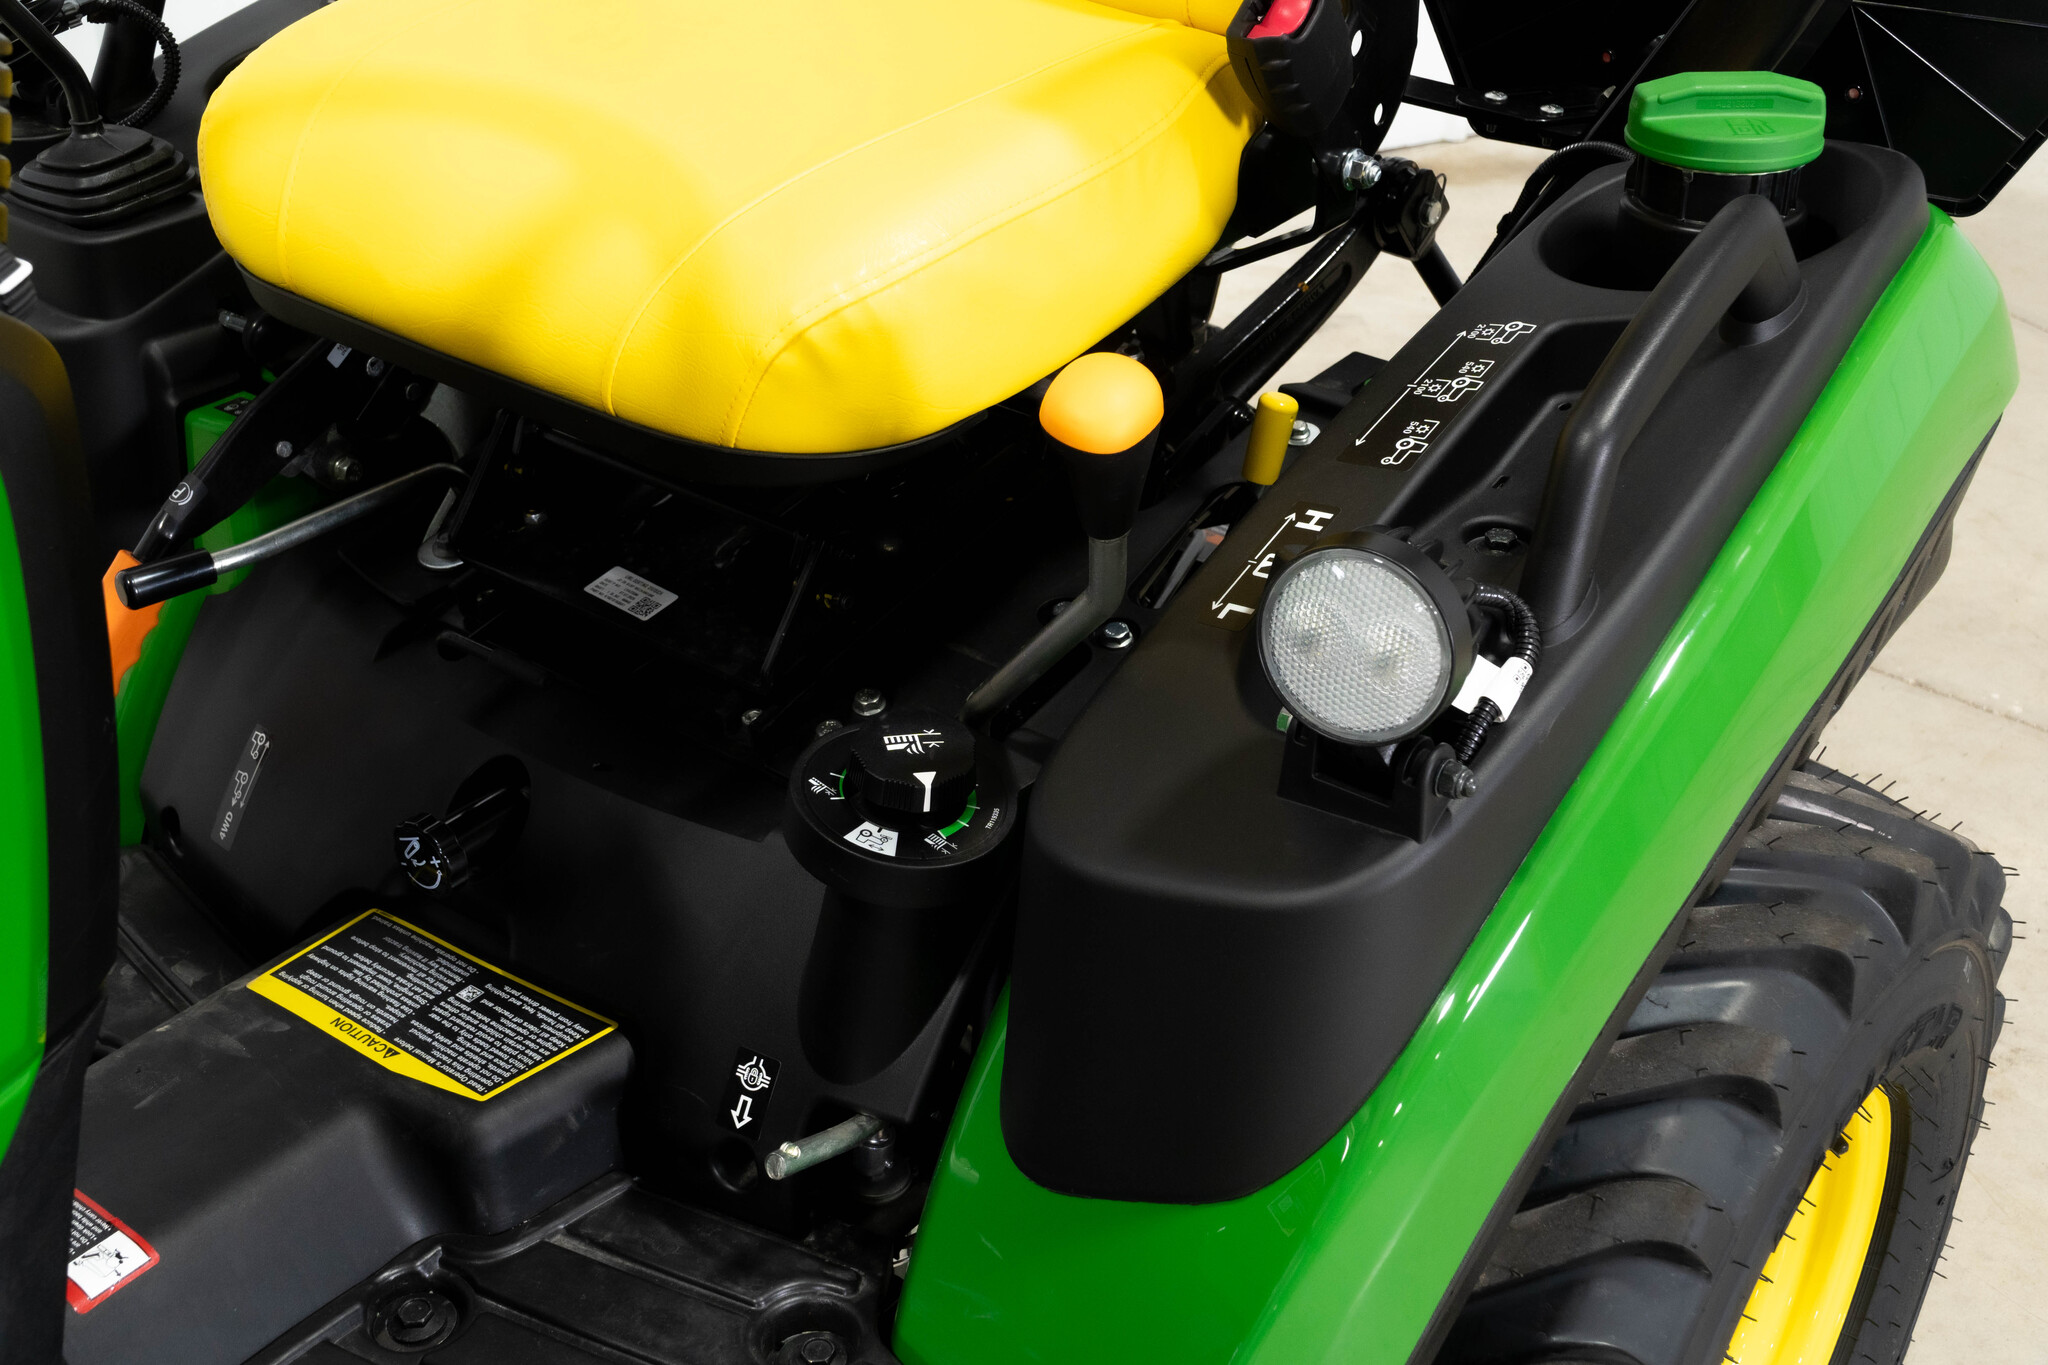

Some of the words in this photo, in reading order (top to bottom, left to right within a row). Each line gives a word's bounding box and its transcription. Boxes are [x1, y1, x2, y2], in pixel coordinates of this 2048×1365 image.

[1467, 323, 1486, 339] 2100
[1459, 361, 1474, 374] 540
[1413, 378, 1433, 395] 2100
[1403, 421, 1419, 434] 540
[1294, 509, 1334, 532] H
[1217, 602, 1255, 620] L
[219, 811, 233, 840] 4WD
[392, 925, 411, 936] unless
[350, 935, 370, 947] before
[382, 936, 403, 948] tractor
[410, 935, 435, 949] machine
[321, 945, 344, 957] ground
[368, 944, 383, 953] stop
[401, 945, 424, 960] leaving
[434, 947, 457, 962] operate
[307, 953, 331, 968] highway
[353, 952, 373, 965] before
[387, 955, 419, 973] movement
[305, 968, 323, 979] steep
[337, 969, 355, 981] lights
[371, 962, 397, 978] securely
[428, 968, 456, 986] servicing
[438, 966, 463, 982] Remove
[278, 970, 303, 985] applying
[299, 973, 318, 985] rough
[375, 974, 393, 985] lower
[395, 976, 413, 988] brake
[314, 982, 337, 996] around
[327, 980, 351, 994] ground
[353, 977, 378, 993] warning
[369, 979, 402, 998] prohibited
[433, 981, 448, 991] Wait
[484, 983, 510, 999] clothing
[503, 985, 522, 996] parts.
[308, 986, 330, 1001] turning
[348, 992, 368, 1005] rough
[412, 994, 428, 1005] Stop
[519, 994, 540, 1007] driven
[328, 998, 345, 1009] when
[336, 993, 364, 1012] operating
[399, 996, 420, 1009] unless
[439, 1001, 460, 1014] others
[447, 996, 471, 1012] starting
[342, 1007, 362, 1020] speed
[374, 1007, 399, 1023] hazards
[428, 1012, 442, 1022] rear
[470, 1009, 491, 1023] before
[492, 1005, 514, 1019] tractor
[538, 1005, 560, 1017] power
[361, 1018, 384, 1033] Reduce
[370, 1014, 392, 1028] brakes
[448, 1015, 478, 1032] rearward
[458, 1012, 480, 1025] and/or
[557, 1015, 573, 1026] from
[410, 1019, 434, 1034] devices
[478, 1023, 504, 1038] children
[489, 1020, 516, 1037] machine
[500, 1017, 529, 1035] operation.
[522, 1021, 542, 1034] riders
[540, 1022, 574, 1043] equipment.
[564, 1027, 582, 1039] Keep
[572, 1023, 590, 1034] away
[329, 1017, 388, 1052] CAUTION
[408, 1028, 432, 1042] without
[458, 1029, 474, 1039] only
[475, 1030, 495, 1042] avoid
[393, 1037, 414, 1051] before
[431, 1040, 458, 1057] machine
[456, 1036, 481, 1053] working.
[472, 1037, 491, 1049] loads
[503, 1036, 526, 1051] certain
[522, 1039, 540, 1050] clear
[536, 1038, 558, 1051] engine
[548, 1036, 566, 1048] Keep
[412, 1048, 436, 1063] Manual
[463, 1050, 487, 1064] shields
[488, 1046, 510, 1060] towed
[501, 1044, 520, 1056] plate
[524, 1049, 542, 1061] Make
[451, 1061, 465, 1071] this
[457, 1055, 481, 1070] operate
[493, 1057, 513, 1069] place
[508, 1057, 526, 1069] Hitch
[517, 1053, 534, 1065] hitch
[463, 1067, 494, 1086] operating
[467, 1079, 486, 1091] Read
